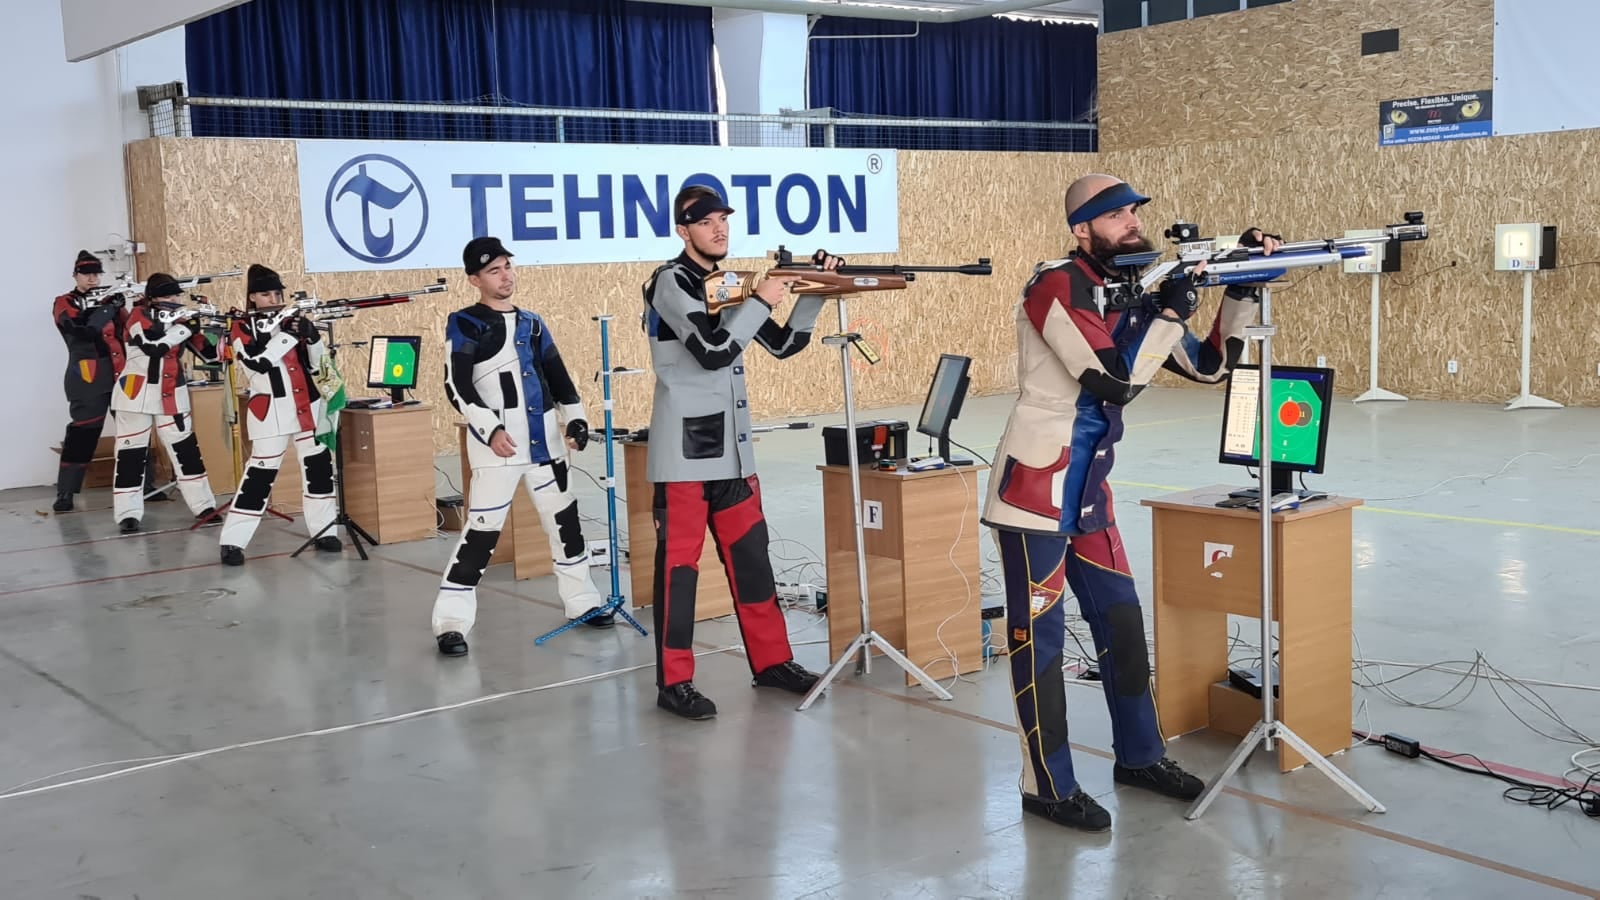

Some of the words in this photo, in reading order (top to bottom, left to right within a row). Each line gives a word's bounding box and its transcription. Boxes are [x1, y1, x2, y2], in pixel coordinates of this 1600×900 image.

[1392, 100, 1419, 108] Precise.
[1421, 96, 1450, 105] Flexible.
[1451, 94, 1479, 102] Unique.
[1512, 259, 1520, 268] D
[869, 506, 878, 523] F
